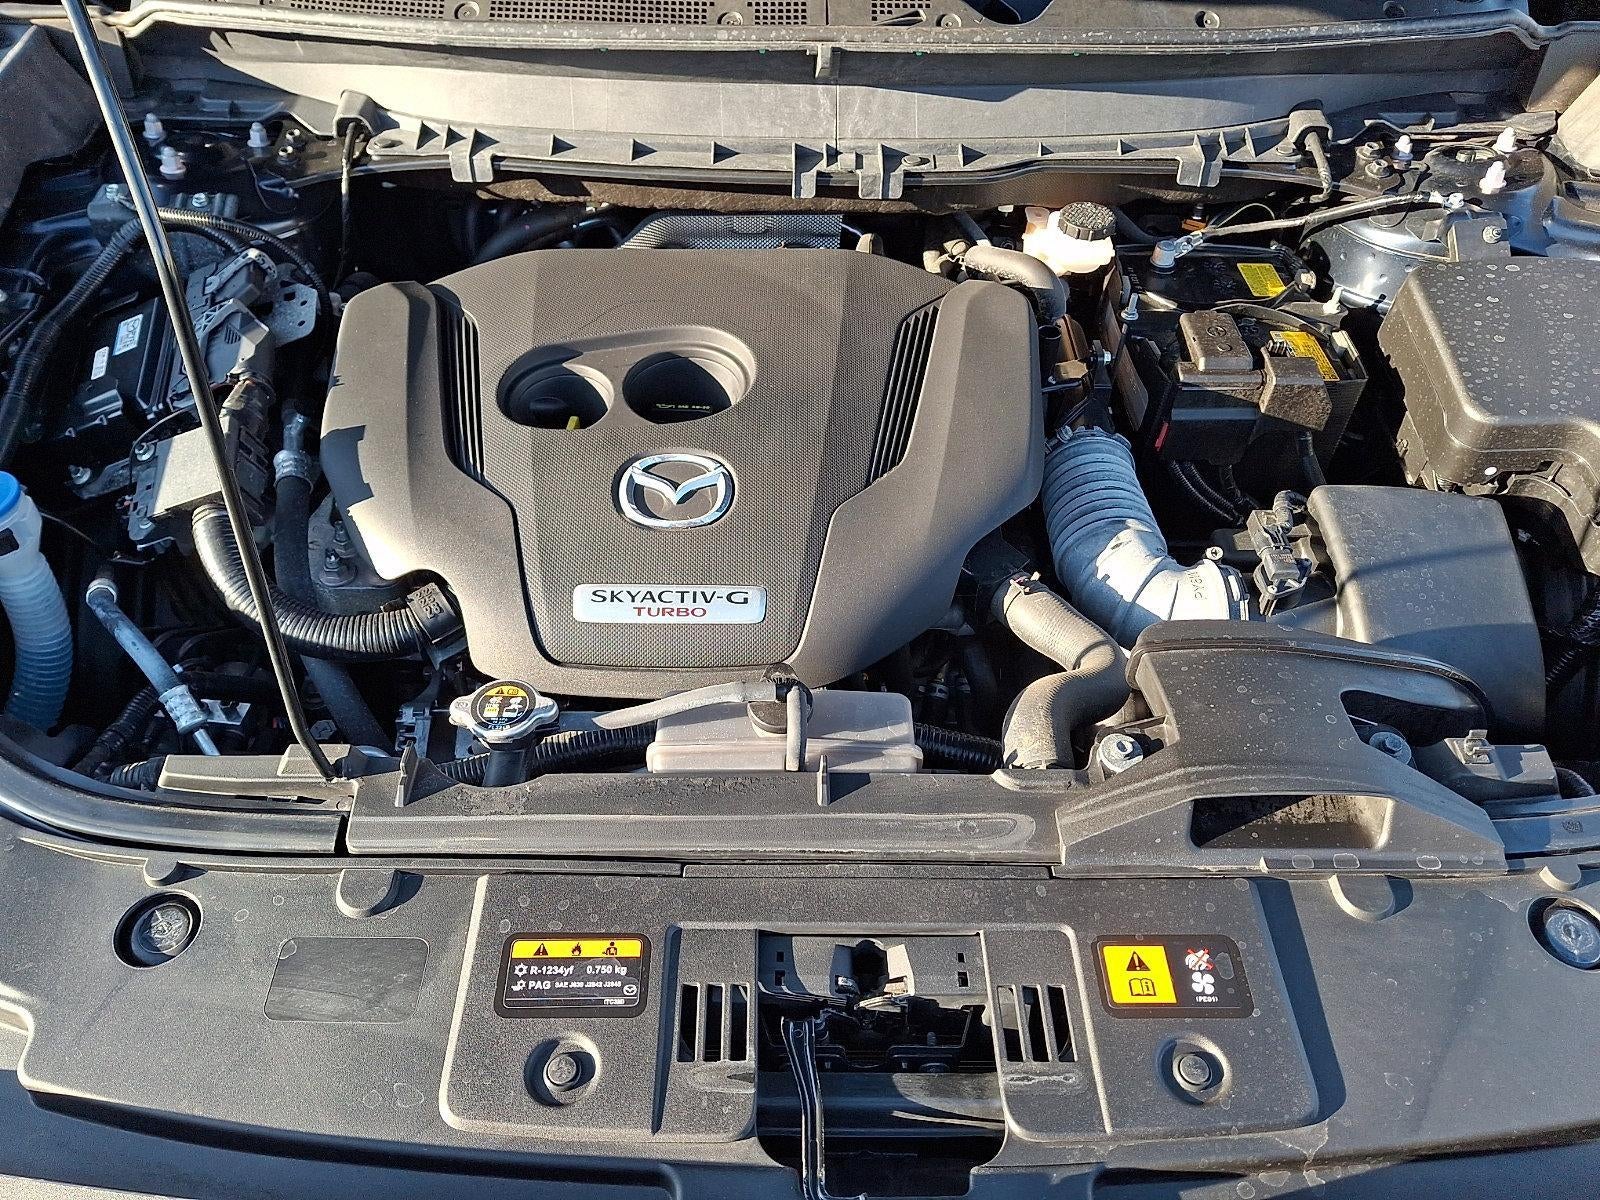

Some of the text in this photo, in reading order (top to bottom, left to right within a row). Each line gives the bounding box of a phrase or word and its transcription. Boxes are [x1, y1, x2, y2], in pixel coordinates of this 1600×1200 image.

[591, 589, 749, 605] SKYACTIV-G
[423, 602, 444, 619] 28
[633, 606, 707, 617] TURBO
[529, 964, 628, 977] R-1234yf 0.750 kg
[528, 980, 551, 990] PAG
